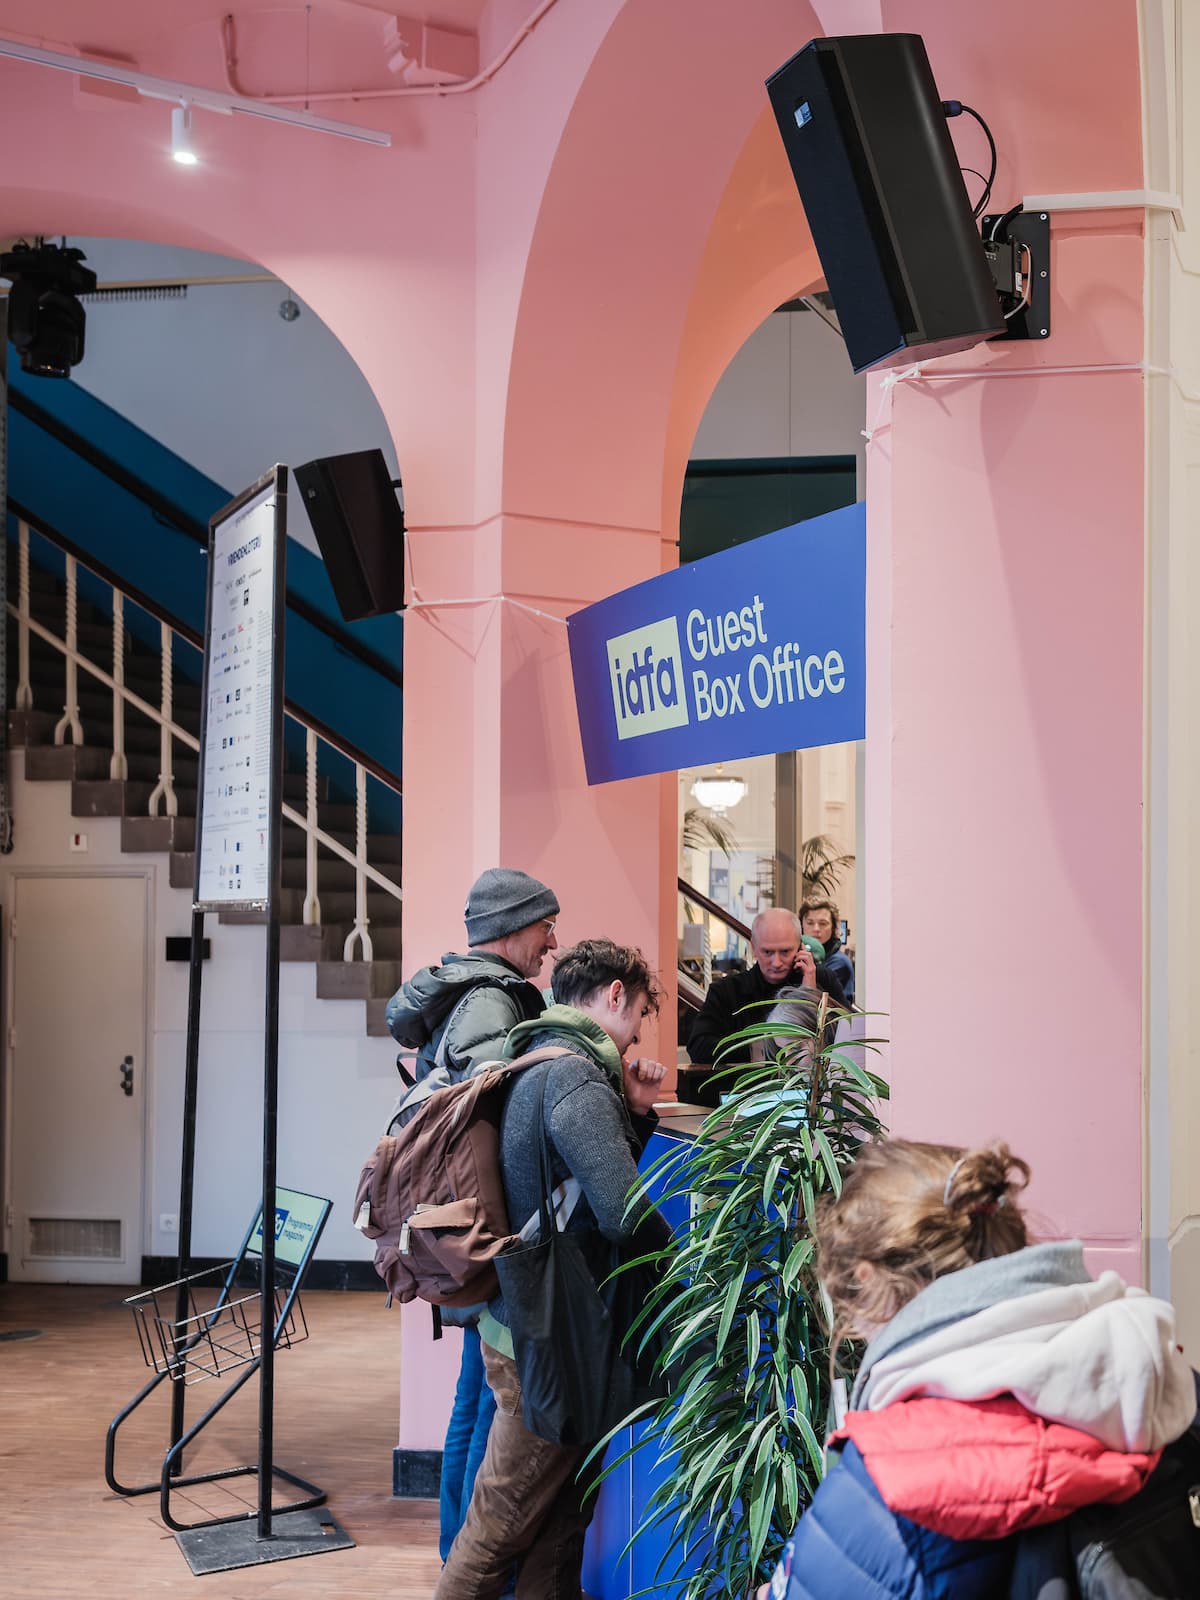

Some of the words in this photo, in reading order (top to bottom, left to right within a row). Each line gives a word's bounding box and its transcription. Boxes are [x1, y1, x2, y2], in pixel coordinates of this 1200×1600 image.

[686, 594, 768, 661] Guest
[615, 646, 679, 719] idfa
[692, 669, 746, 722] Box
[748, 642, 846, 709] Office
